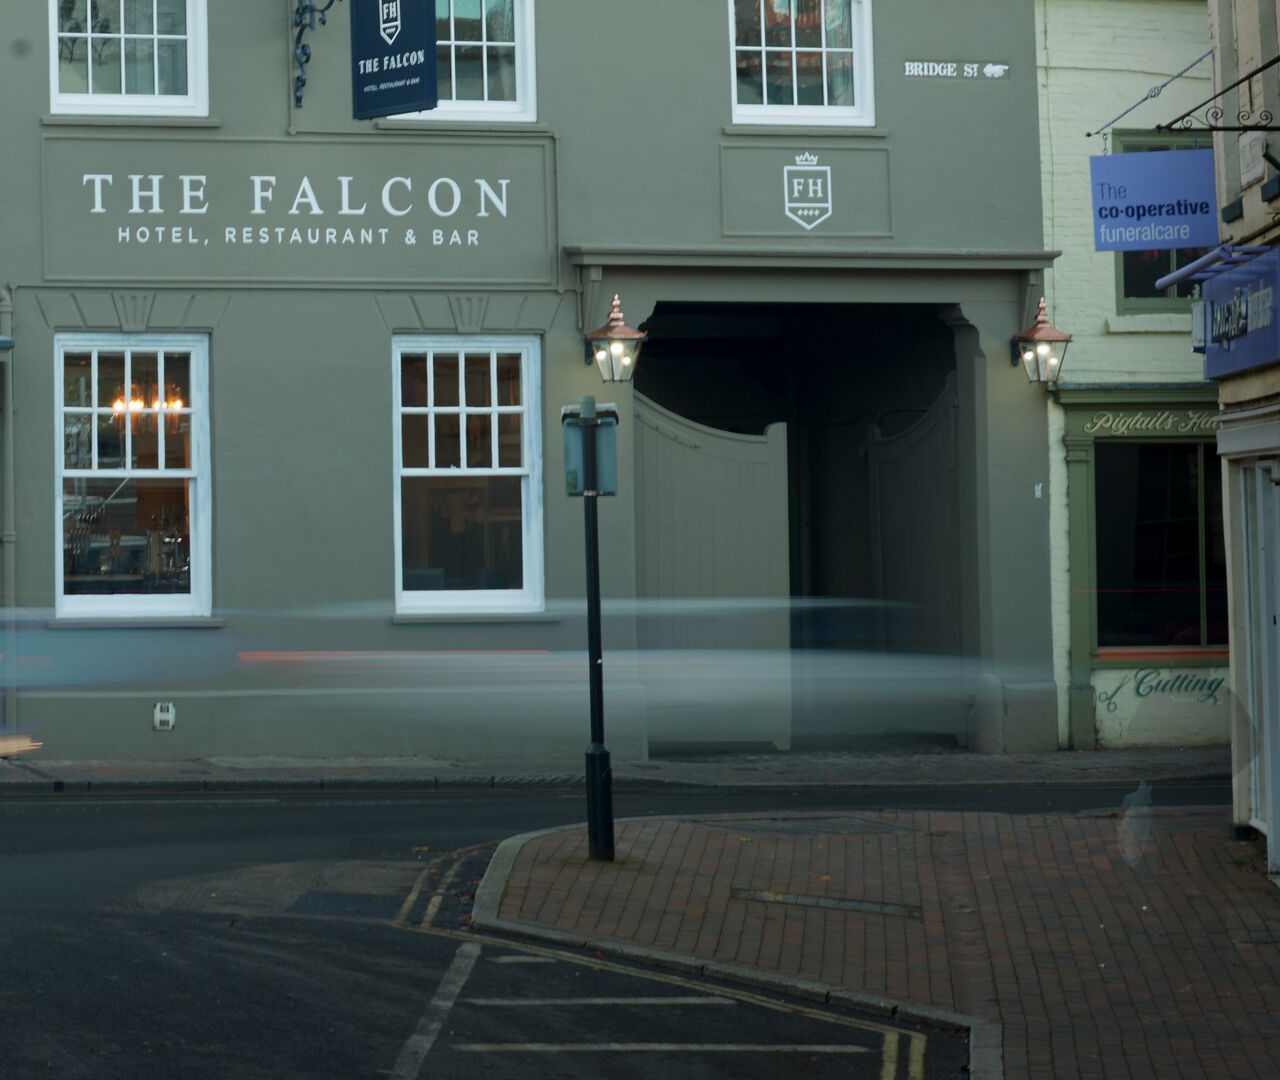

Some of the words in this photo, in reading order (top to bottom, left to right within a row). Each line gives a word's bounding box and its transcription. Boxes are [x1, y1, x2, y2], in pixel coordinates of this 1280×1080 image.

[383, 1, 397, 20] FH
[358, 57, 380, 75] THE
[383, 49, 425, 71] FALCON
[904, 61, 957, 77] BRIDGE
[82, 174, 209, 214] THE
[250, 175, 511, 218] FALCON
[792, 178, 823, 198] FH
[1097, 182, 1127, 200] The
[1098, 199, 1210, 221] co-operative
[118, 226, 209, 246] HOTEL,
[225, 227, 389, 245] RESTAURANT
[405, 228, 417, 245] &
[432, 229, 480, 246] BAR
[1100, 222, 1190, 243] funeralcare
[1083, 410, 1178, 435] Pigtails
[1135, 668, 1225, 704] Cutting
